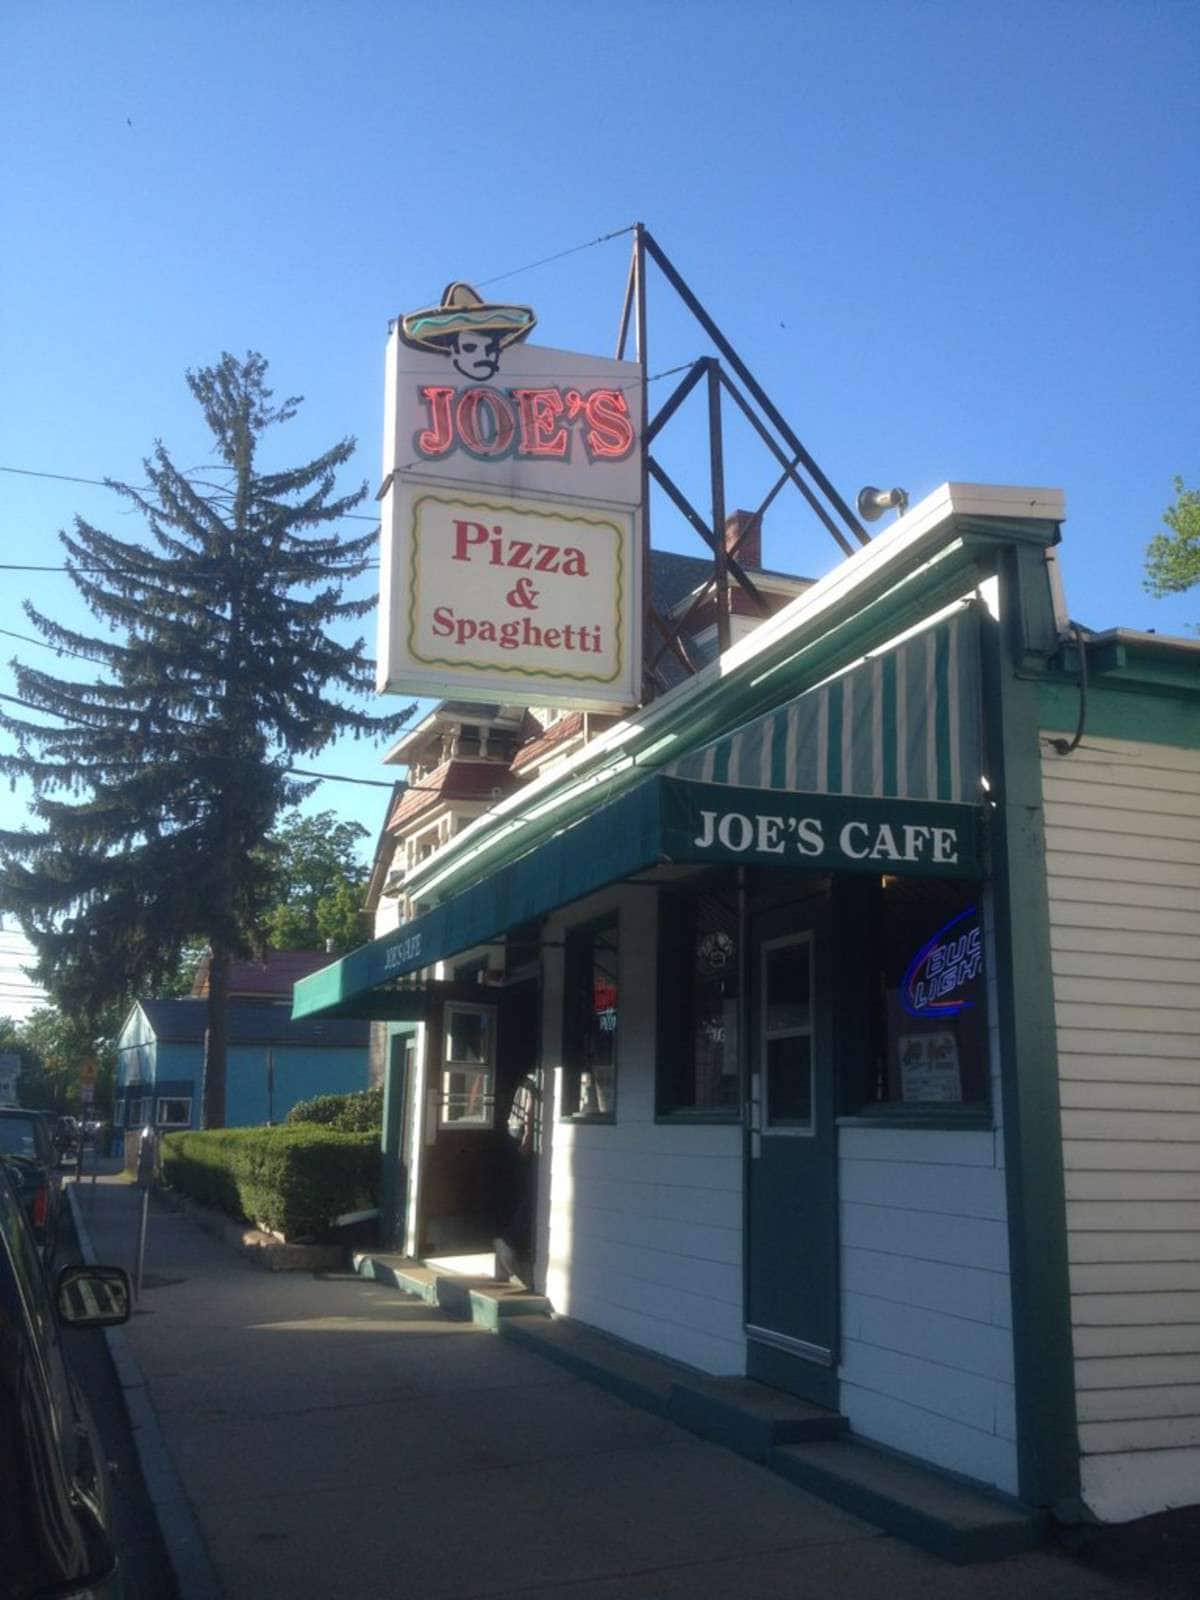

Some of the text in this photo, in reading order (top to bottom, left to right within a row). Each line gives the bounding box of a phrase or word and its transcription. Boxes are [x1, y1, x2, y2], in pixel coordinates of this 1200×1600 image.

[417, 385, 637, 461] JOE'S
[452, 520, 589, 577] Pizza
[507, 578, 539, 609] &
[432, 607, 603, 653] Spaghetti
[694, 811, 958, 863] JOE'S CAFE
[914, 950, 982, 1009] LIGH
